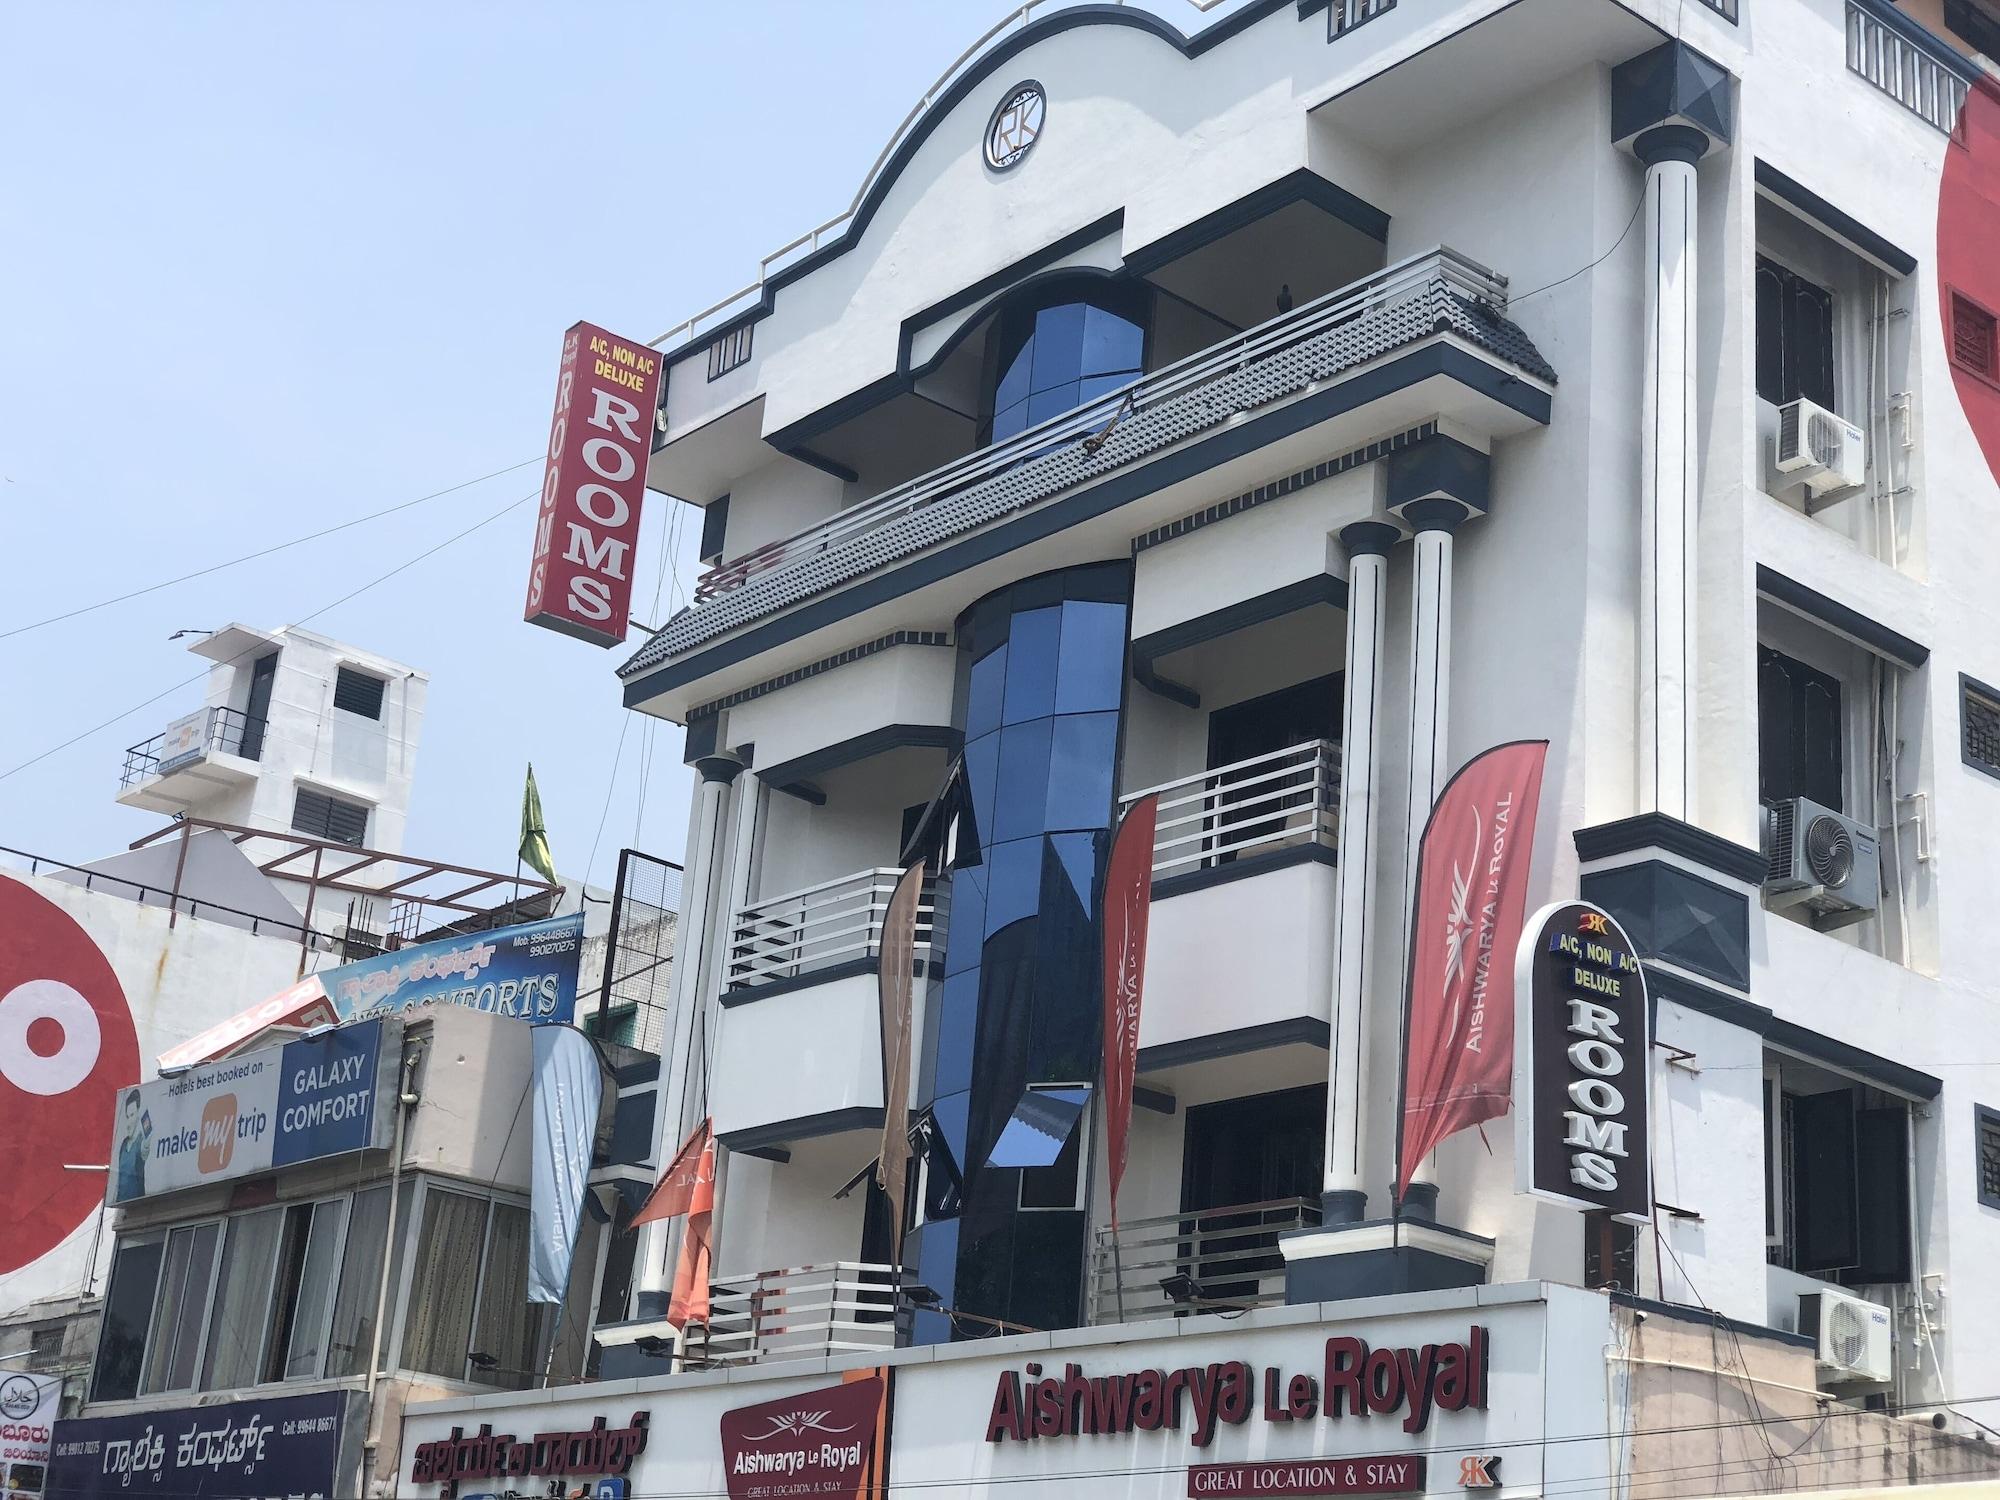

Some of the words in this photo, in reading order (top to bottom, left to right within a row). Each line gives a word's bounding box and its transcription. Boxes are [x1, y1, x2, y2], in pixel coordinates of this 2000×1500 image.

[590, 336, 609, 360] A/C,
[613, 345, 635, 368] NON
[636, 356, 654, 375] A/C
[595, 359, 644, 392] DELUXE
[530, 371, 573, 608] ROOMS
[562, 387, 642, 620] ROOMS
[513, 935, 529, 947] Mob:
[1466, 902, 1497, 1054] AISHWARYA
[1489, 792, 1512, 875] ROYAL
[529, 940, 575, 957] 9901270275
[1560, 934, 1582, 958] A/C,
[1587, 943, 1612, 965] NON
[1619, 953, 1638, 973] A/C
[1575, 968, 1620, 997] DELUXE
[168, 1078, 195, 1097] Hotels
[196, 1074, 215, 1089] best
[217, 1064, 249, 1083] booked
[252, 1062, 263, 1074] on
[294, 1054, 366, 1095] GALAXY
[283, 1090, 370, 1133] COMFORT
[1563, 999, 1629, 1192] ROOMS
[157, 1128, 197, 1158] make
[202, 1111, 236, 1164] my
[237, 1108, 266, 1141] trip
[985, 1360, 1254, 1447] Aishwarya
[1264, 1367, 1319, 1422] Le
[1324, 1326, 1490, 1433] Royal
[733, 1449, 805, 1476] Aishwarya
[808, 1450, 819, 1465] Le
[820, 1441, 861, 1473] Royal
[1194, 1470, 1245, 1491] GREAT
[1253, 1466, 1336, 1489] LOCATION
[1345, 1464, 1357, 1485] &
[1366, 1463, 1408, 1485] STAY
[747, 1486, 771, 1499] GREAT
[773, 1483, 811, 1496] LOCATION
[823, 1480, 842, 1491] STAY
